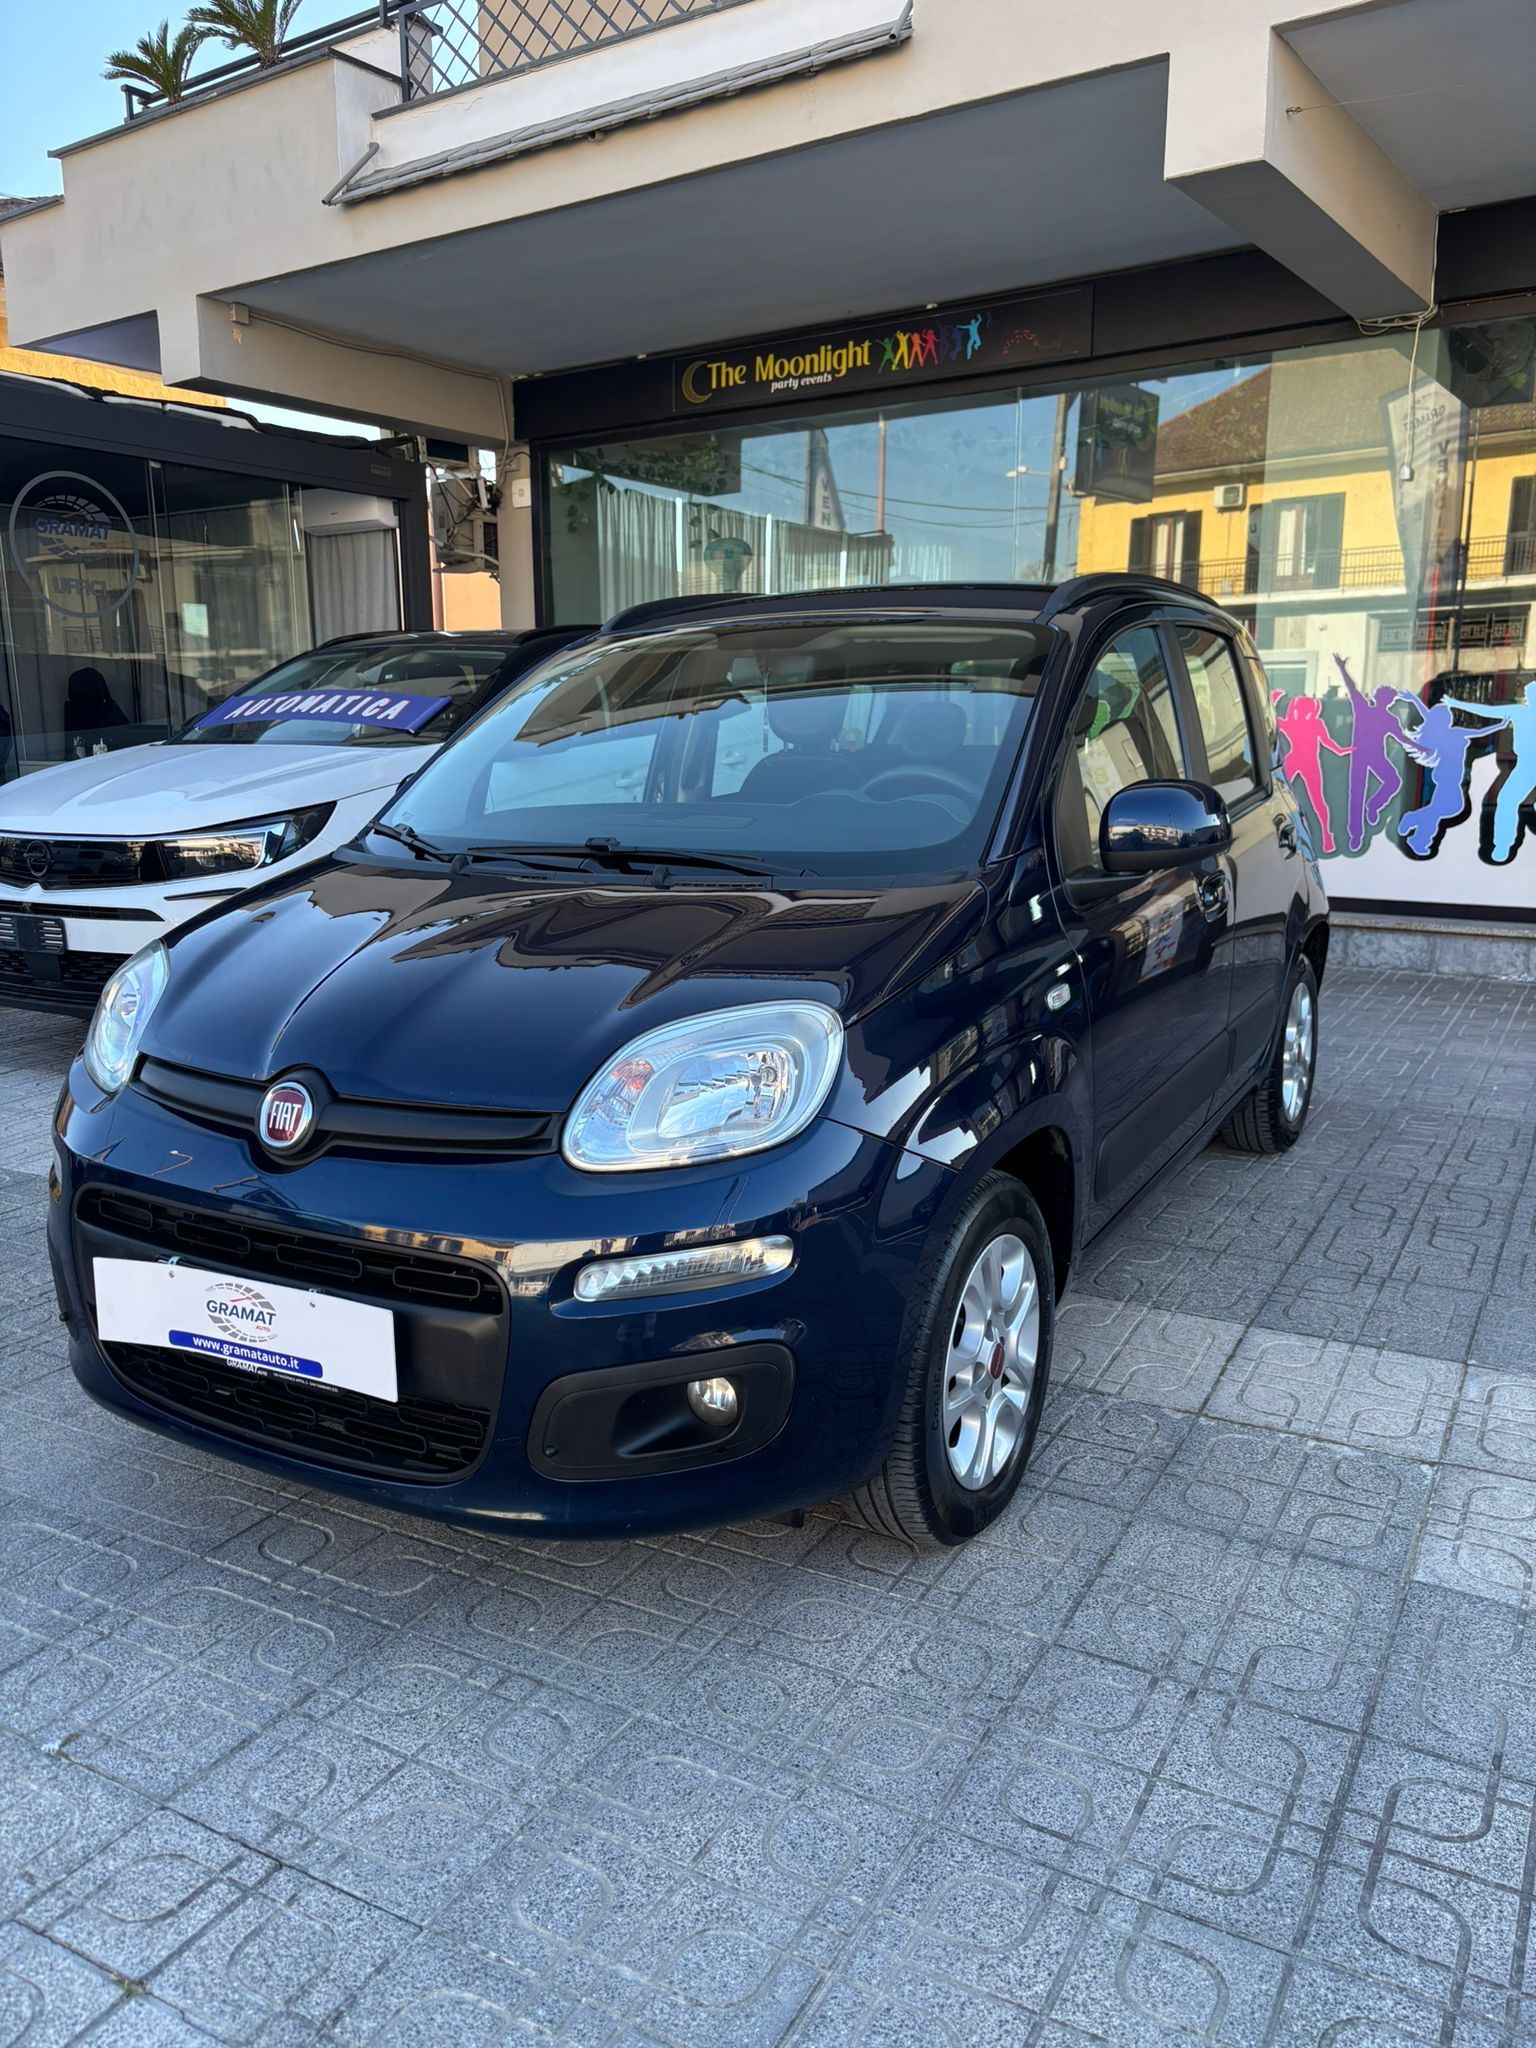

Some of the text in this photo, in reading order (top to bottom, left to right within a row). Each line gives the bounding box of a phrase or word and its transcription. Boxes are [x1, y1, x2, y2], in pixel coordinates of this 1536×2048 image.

[707, 339, 872, 389] The Moonlight
[770, 373, 833, 393] party events
[35, 517, 112, 541] GRAMAT
[224, 694, 411, 720] AUTOMATICA
[268, 1101, 302, 1131] FIAT
[206, 1299, 277, 1326] GRAMAT
[255, 1324, 271, 1333] AUTO
[192, 1336, 300, 1370] www.gramatauto.it
[226, 1358, 258, 1373] GRAMAT
